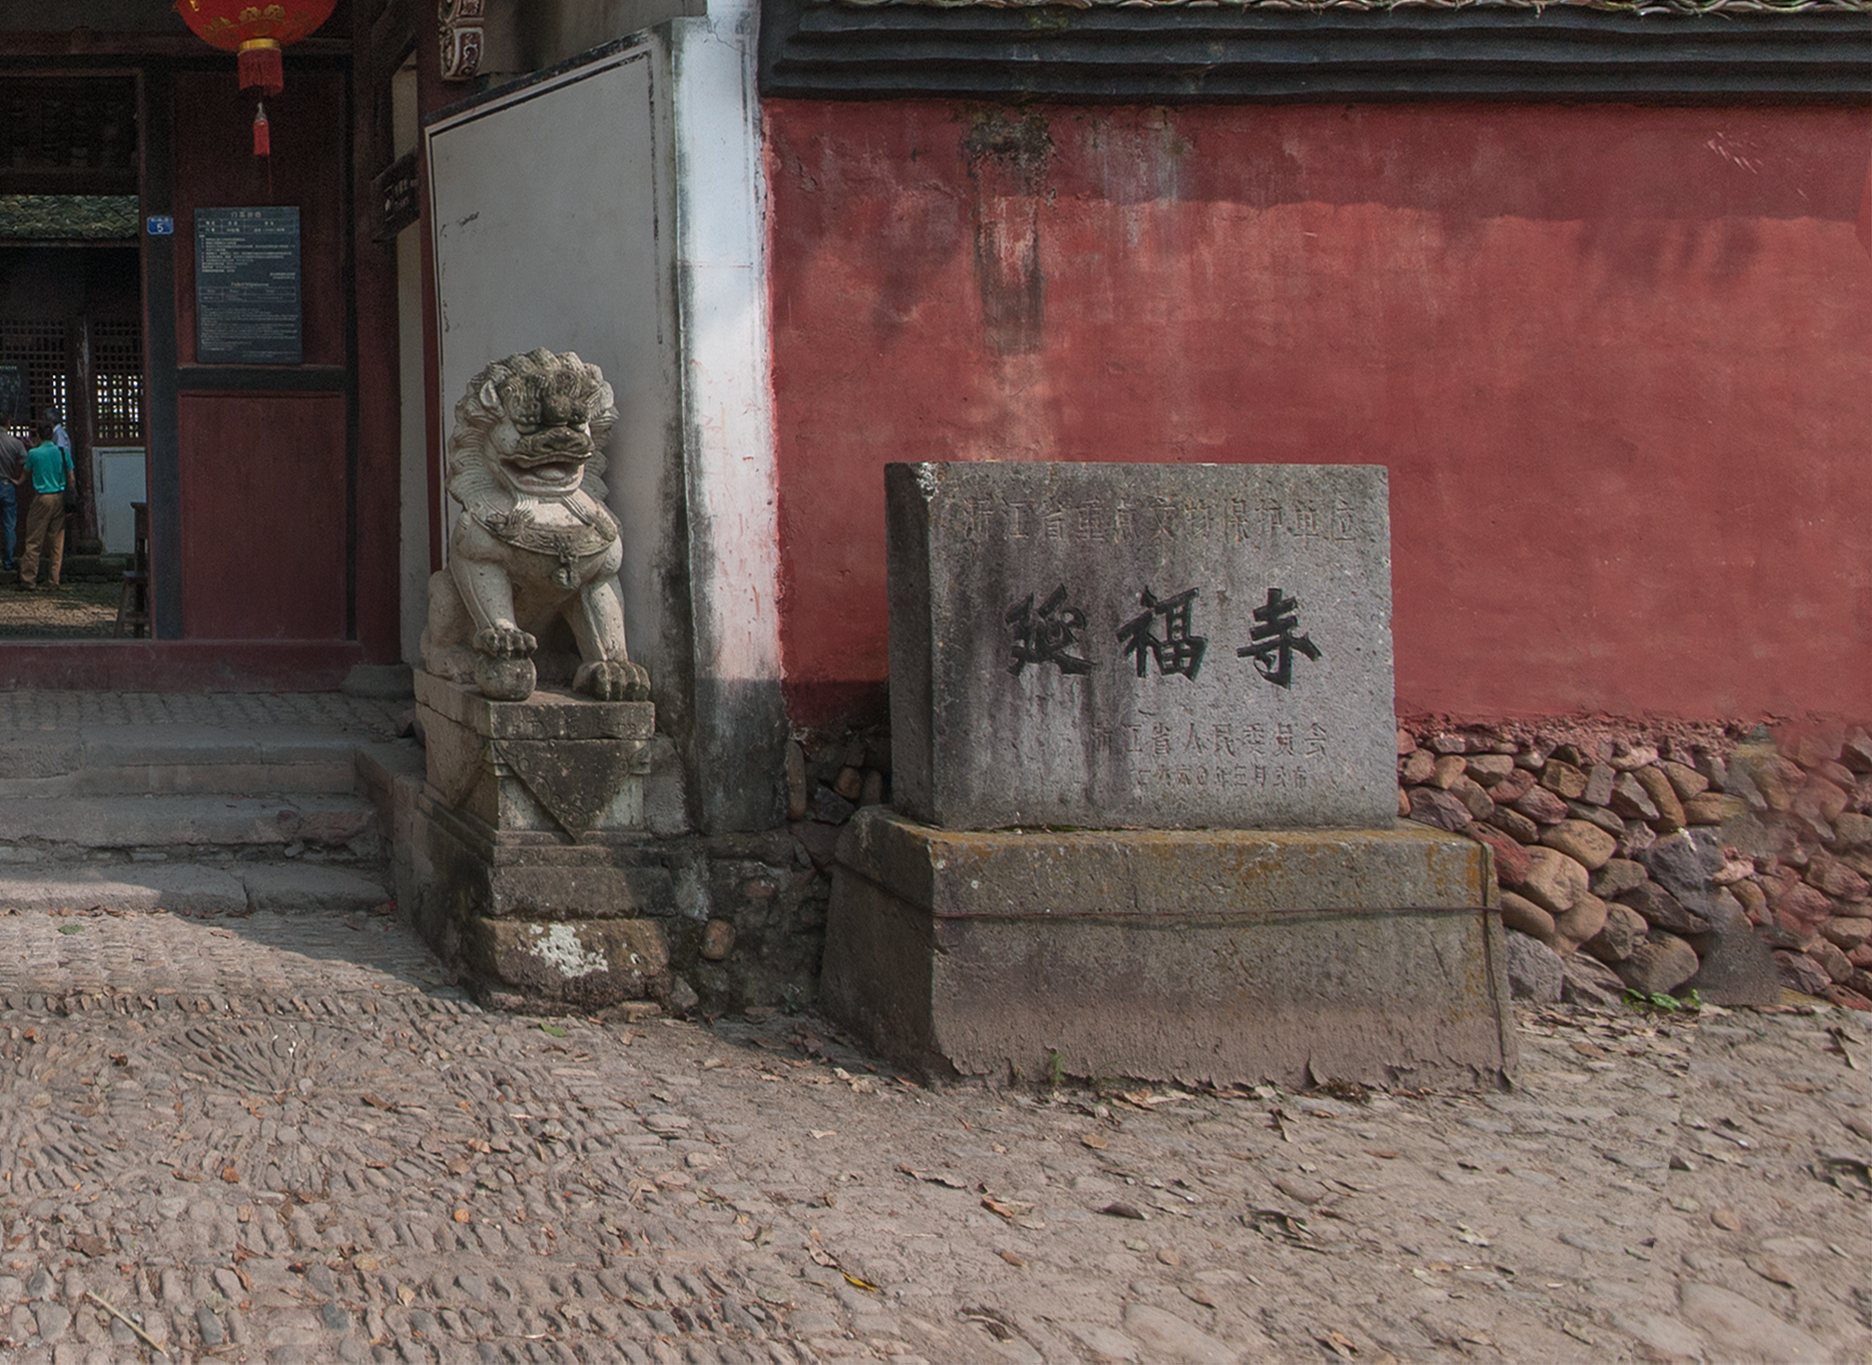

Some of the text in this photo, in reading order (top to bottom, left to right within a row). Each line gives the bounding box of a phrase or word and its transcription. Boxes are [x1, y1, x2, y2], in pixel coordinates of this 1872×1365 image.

[1004, 583, 1323, 690] 延福寺
[1088, 721, 1327, 758] 浙江省人民委员会
